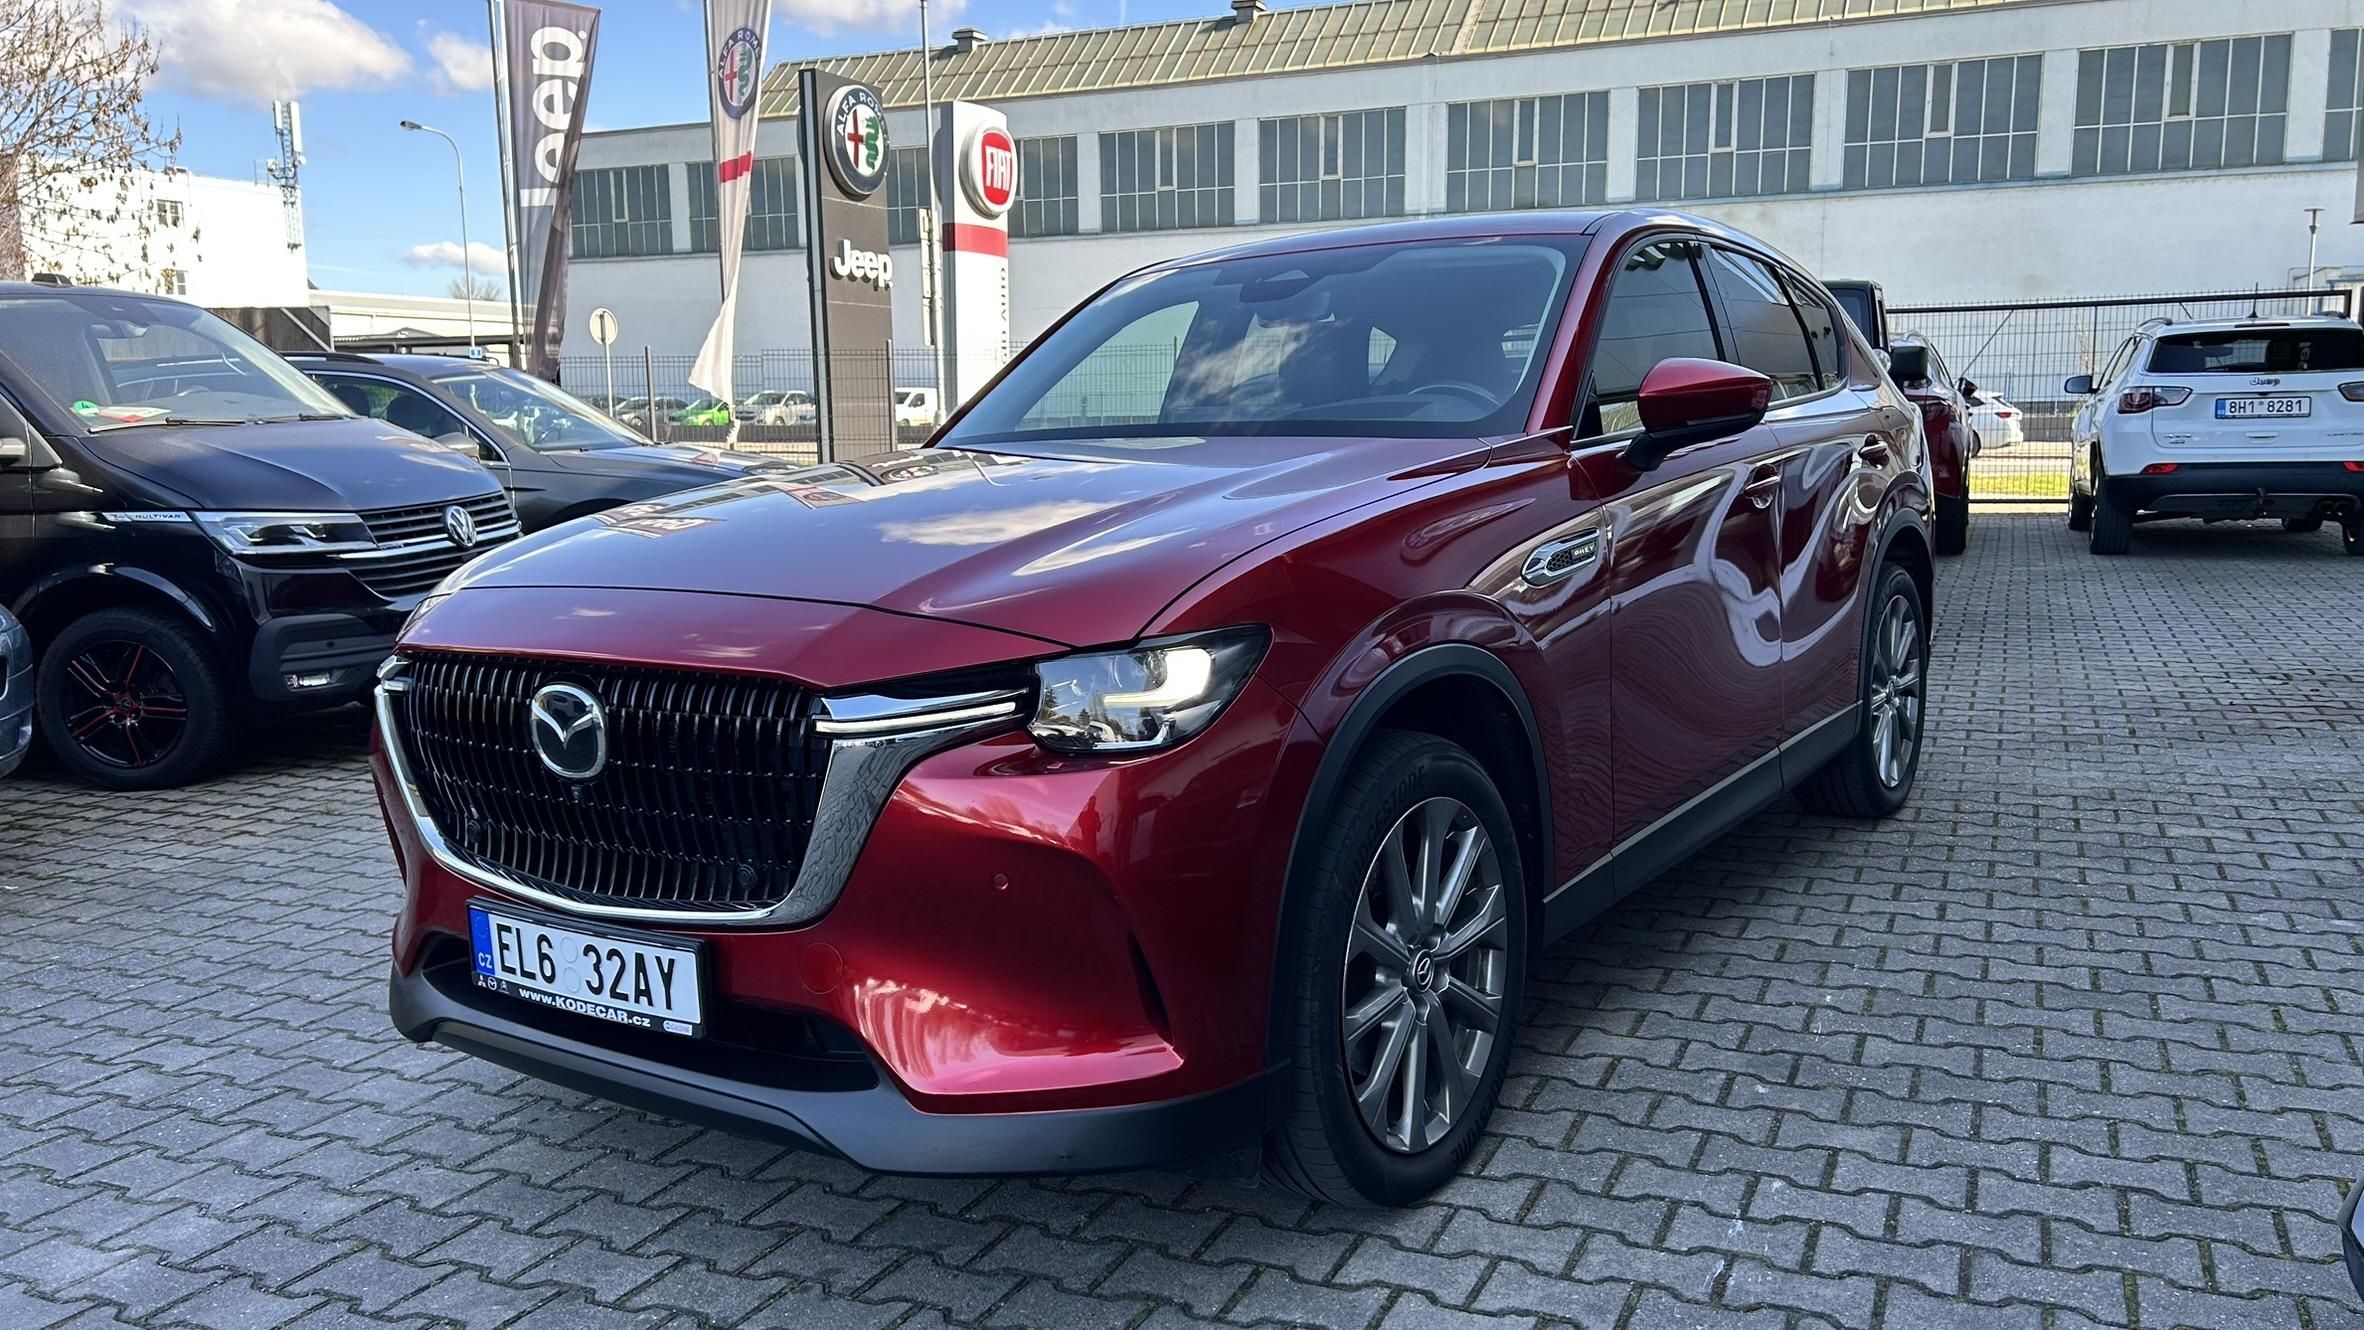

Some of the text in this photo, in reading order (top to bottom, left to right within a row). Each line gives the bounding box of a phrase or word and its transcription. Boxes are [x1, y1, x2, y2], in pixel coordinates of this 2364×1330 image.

[837, 95, 857, 136] ALFA
[985, 145, 1012, 192] FIAT
[834, 239, 893, 288] Jeep
[2229, 401, 2255, 414] 8H1
[2267, 399, 2303, 413] 8281
[478, 951, 493, 969] CZ
[496, 923, 676, 1010] EL6 32AY
[518, 988, 651, 1028] www.KODECAR.cz
